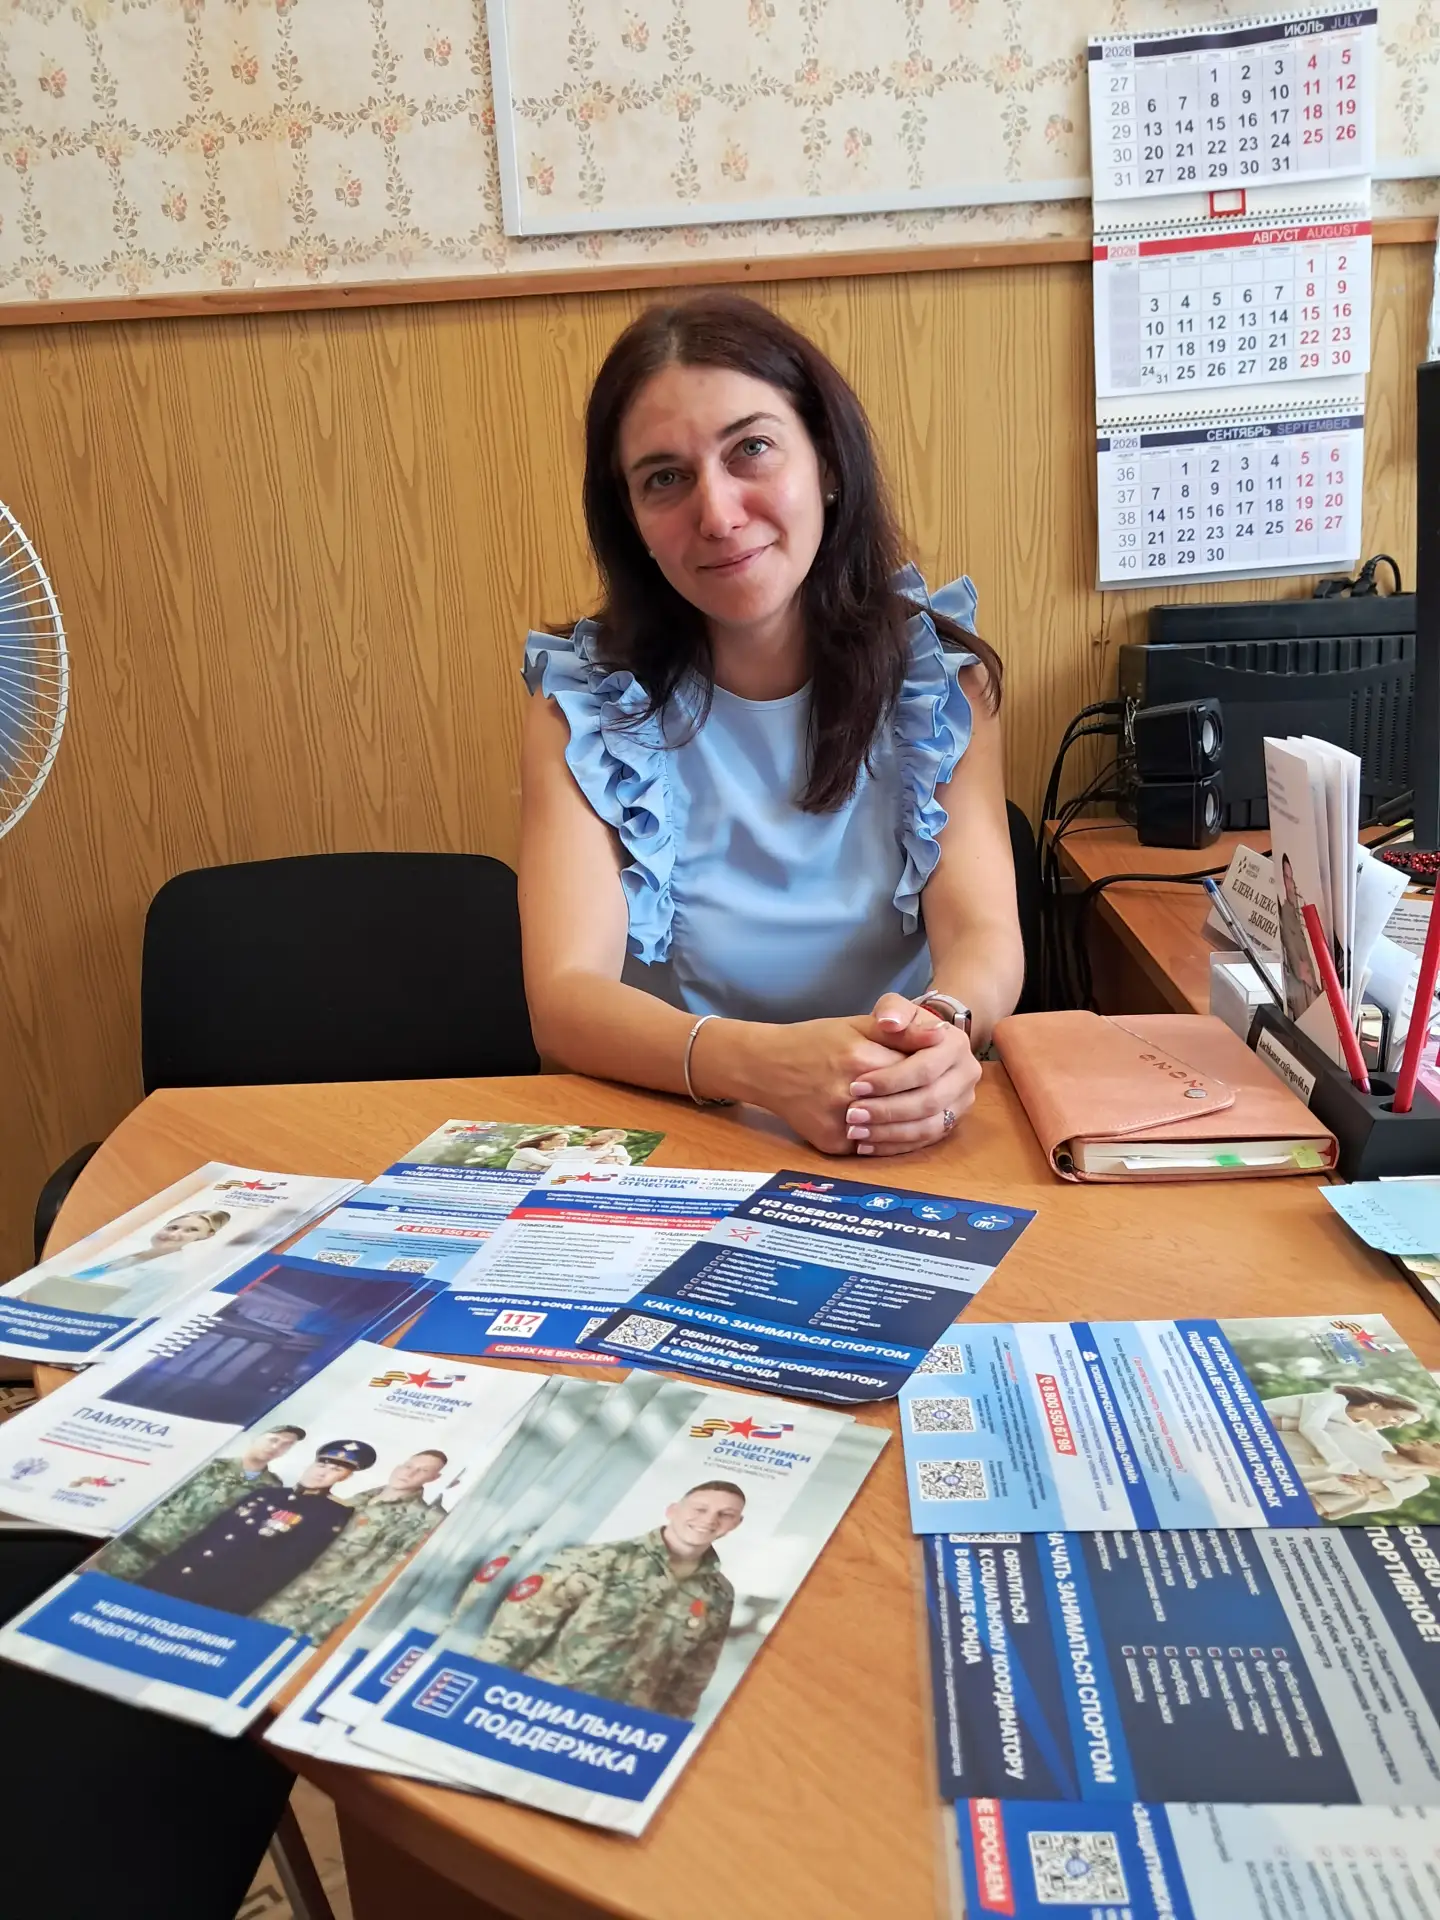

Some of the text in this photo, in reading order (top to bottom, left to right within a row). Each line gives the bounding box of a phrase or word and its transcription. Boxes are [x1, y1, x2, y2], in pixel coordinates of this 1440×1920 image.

[1284, 14, 1363, 38] ИЮЛЬ JULY
[1105, 46, 1132, 57] 2026
[1210, 69, 1217, 83] 1
[1241, 65, 1251, 81] 2
[1274, 60, 1284, 76] 3
[1307, 55, 1318, 70] 4
[1341, 49, 1351, 65] 5
[1147, 74, 1356, 113] 6 7 8 9 10 11 12
[1144, 100, 1356, 137] 13 14 15 16 17 18 19
[1145, 124, 1357, 161] 20 21 22 23 24 25 26
[1146, 157, 1290, 184] 27 28 29 30 31
[1253, 225, 1359, 243] АВГУСТ AUGUST
[1110, 246, 1137, 258] 2026
[1112, 438, 1138, 449] 2026
[1207, 419, 1350, 441] СЕНТЯБРЬ SEPTEMBER
[1181, 449, 1340, 475] 1 2 3 4 5 6
[1151, 471, 1344, 501] 7 8 9 10 11 12 13
[1149, 493, 1343, 523] 14 15 16 17 18 19 20
[1148, 516, 1343, 545] 21 22 23 24 25 26 27
[1149, 548, 1225, 567] 28 29 30
[1232, 879, 1277, 916] ЕЛЕНА АЛЕКС
[618, 1181, 685, 1189] ОТЕЧЕСТВА
[621, 1176, 698, 1184] ЗАЩИТНИКИ
[749, 1207, 884, 1239] В СПОРТИВНОЕ!
[758, 1198, 782, 1208] ИЗ
[784, 1203, 859, 1224] БОЕВОГО
[860, 1218, 951, 1240] БРАТСТВА
[454, 1295, 531, 1306] ОБРАЩАЙТЕСЬ
[541, 1302, 573, 1311] ФОНД
[503, 1313, 541, 1326] 117
[643, 1299, 911, 1362] КАК НАЧАТЬ ЗАНИМАТЬСЯ СПОРТОМ
[495, 1344, 536, 1354] СВОИХ
[556, 1351, 615, 1363] БРОСАЕМ
[679, 1328, 760, 1353] ОБРАТИТЬСЯ
[1187, 1330, 1216, 1377] ПОДДЕРЖКА
[660, 1346, 780, 1380] В ФИЛИАЛЕ ФОНДА
[669, 1337, 888, 1388] К СОЦИАЛЬНОМУ КООРДИНАТОРУ
[386, 1395, 453, 1413] ОТЕЧЕСТВА
[393, 1388, 472, 1408] ЗАЩИТНИКИ
[1044, 1392, 1059, 1408] 800
[1209, 1376, 1242, 1421] ВЕТЕРАНОВ
[72, 1406, 170, 1436] ПАМЯТКА
[1049, 1409, 1064, 1427] 550
[1207, 1336, 1299, 1497] КРУГЛОСУТОЧНАЯ ПСИХОЛОГИЧЕСКАЯ
[1232, 1421, 1250, 1440] СВО
[1054, 1427, 1068, 1439] 67
[1058, 1438, 1072, 1452] 98
[713, 1446, 793, 1469] ОТЕЧЕСТВА
[719, 1438, 811, 1463] ЗАЩИТНИКИ
[1244, 1449, 1260, 1463] ИХ
[1251, 1462, 1283, 1508] РОДНЫХ
[1002, 1549, 1029, 1624] ОБРАТИТЬСЯ
[954, 1548, 980, 1665] В ФИЛИАЛЕ ФОНДА
[69, 1611, 140, 1642] КАЖДОГО
[978, 1549, 1025, 1781] К СОЦИАЛЬНОМУ КООРДИНАТОРУ
[1056, 1580, 1095, 1684] ЗАНИМАТЬСЯ
[1078, 1686, 1117, 1784] СПОРТОМ
[484, 1685, 668, 1753] СОЦИАЛЬНАЯ
[463, 1706, 638, 1775] ПОДДЕРЖКА
[978, 1815, 1006, 1902] БРОСАЕМ
